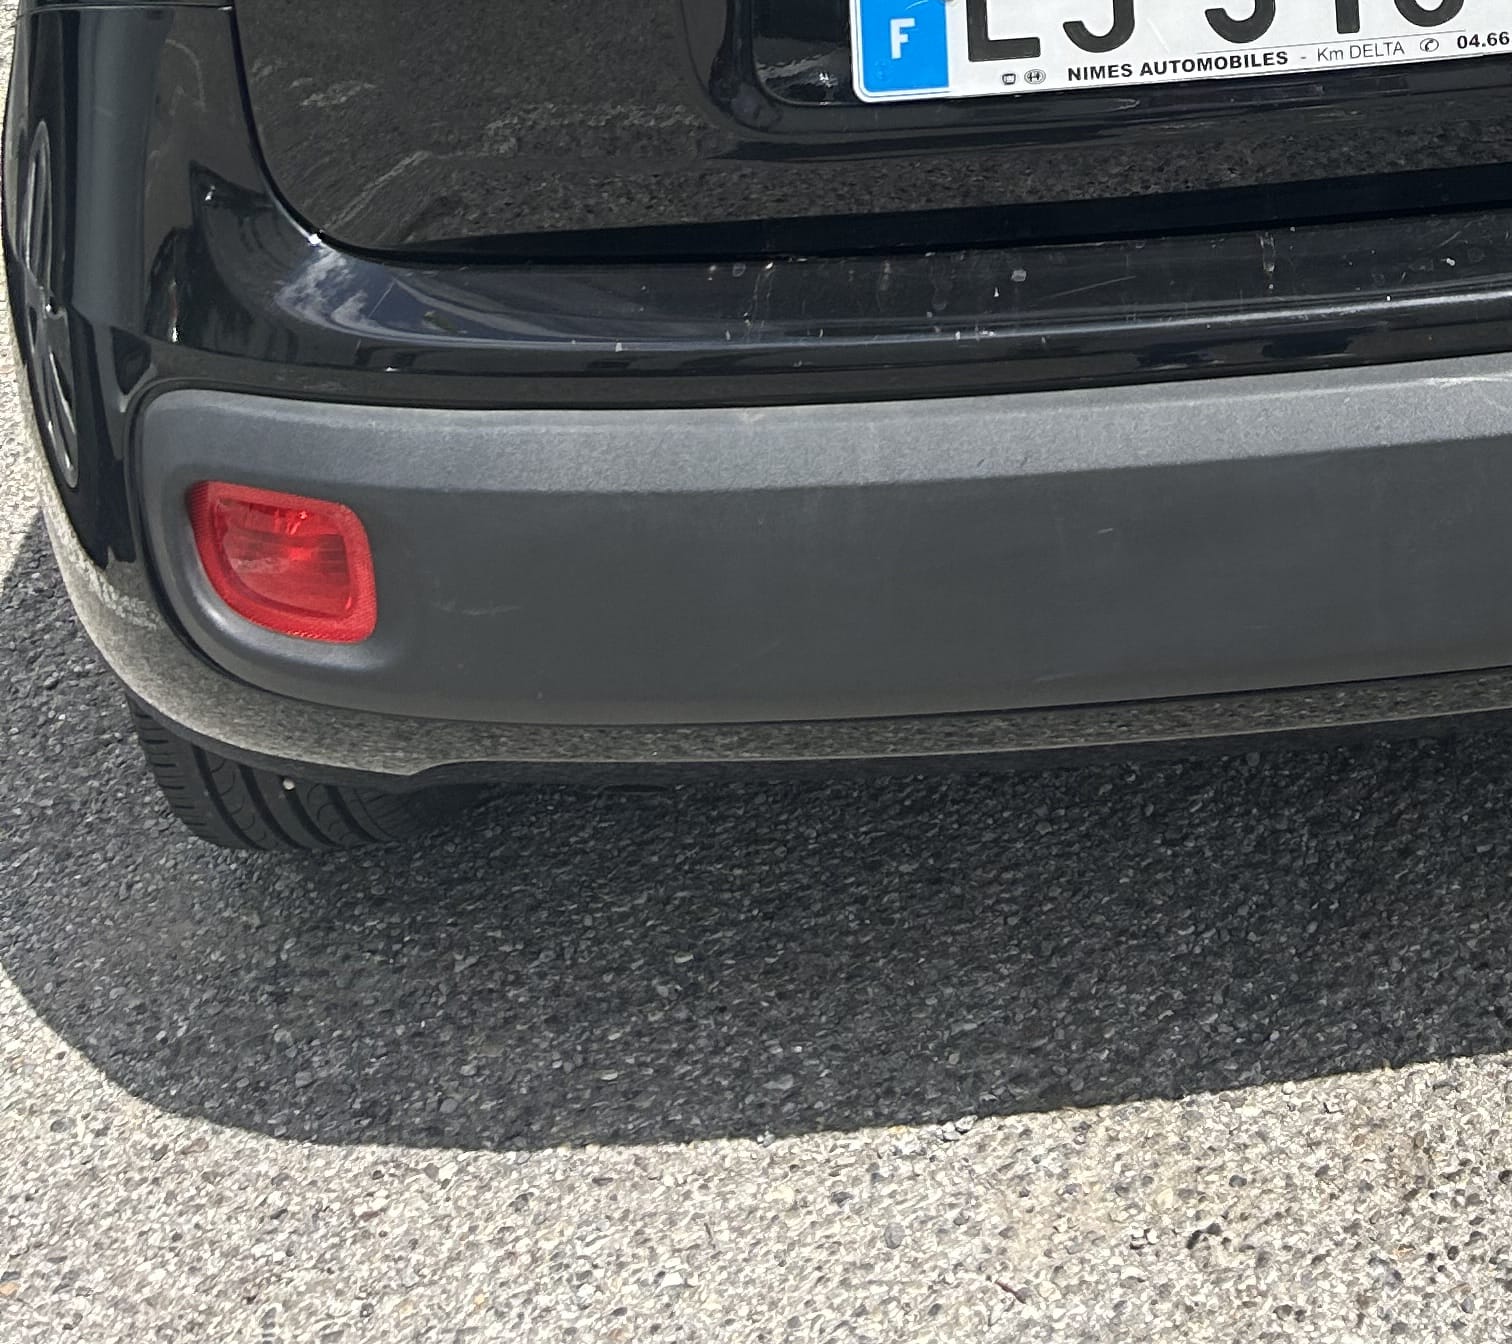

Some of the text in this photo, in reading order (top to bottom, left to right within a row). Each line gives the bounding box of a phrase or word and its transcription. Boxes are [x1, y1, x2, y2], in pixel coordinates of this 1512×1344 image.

[890, 18, 916, 59] F
[1068, 63, 1133, 81] NIMES
[1139, 51, 1289, 76] AUTOMOBILES
[1316, 47, 1344, 62] Km
[1349, 42, 1405, 58] DELTA
